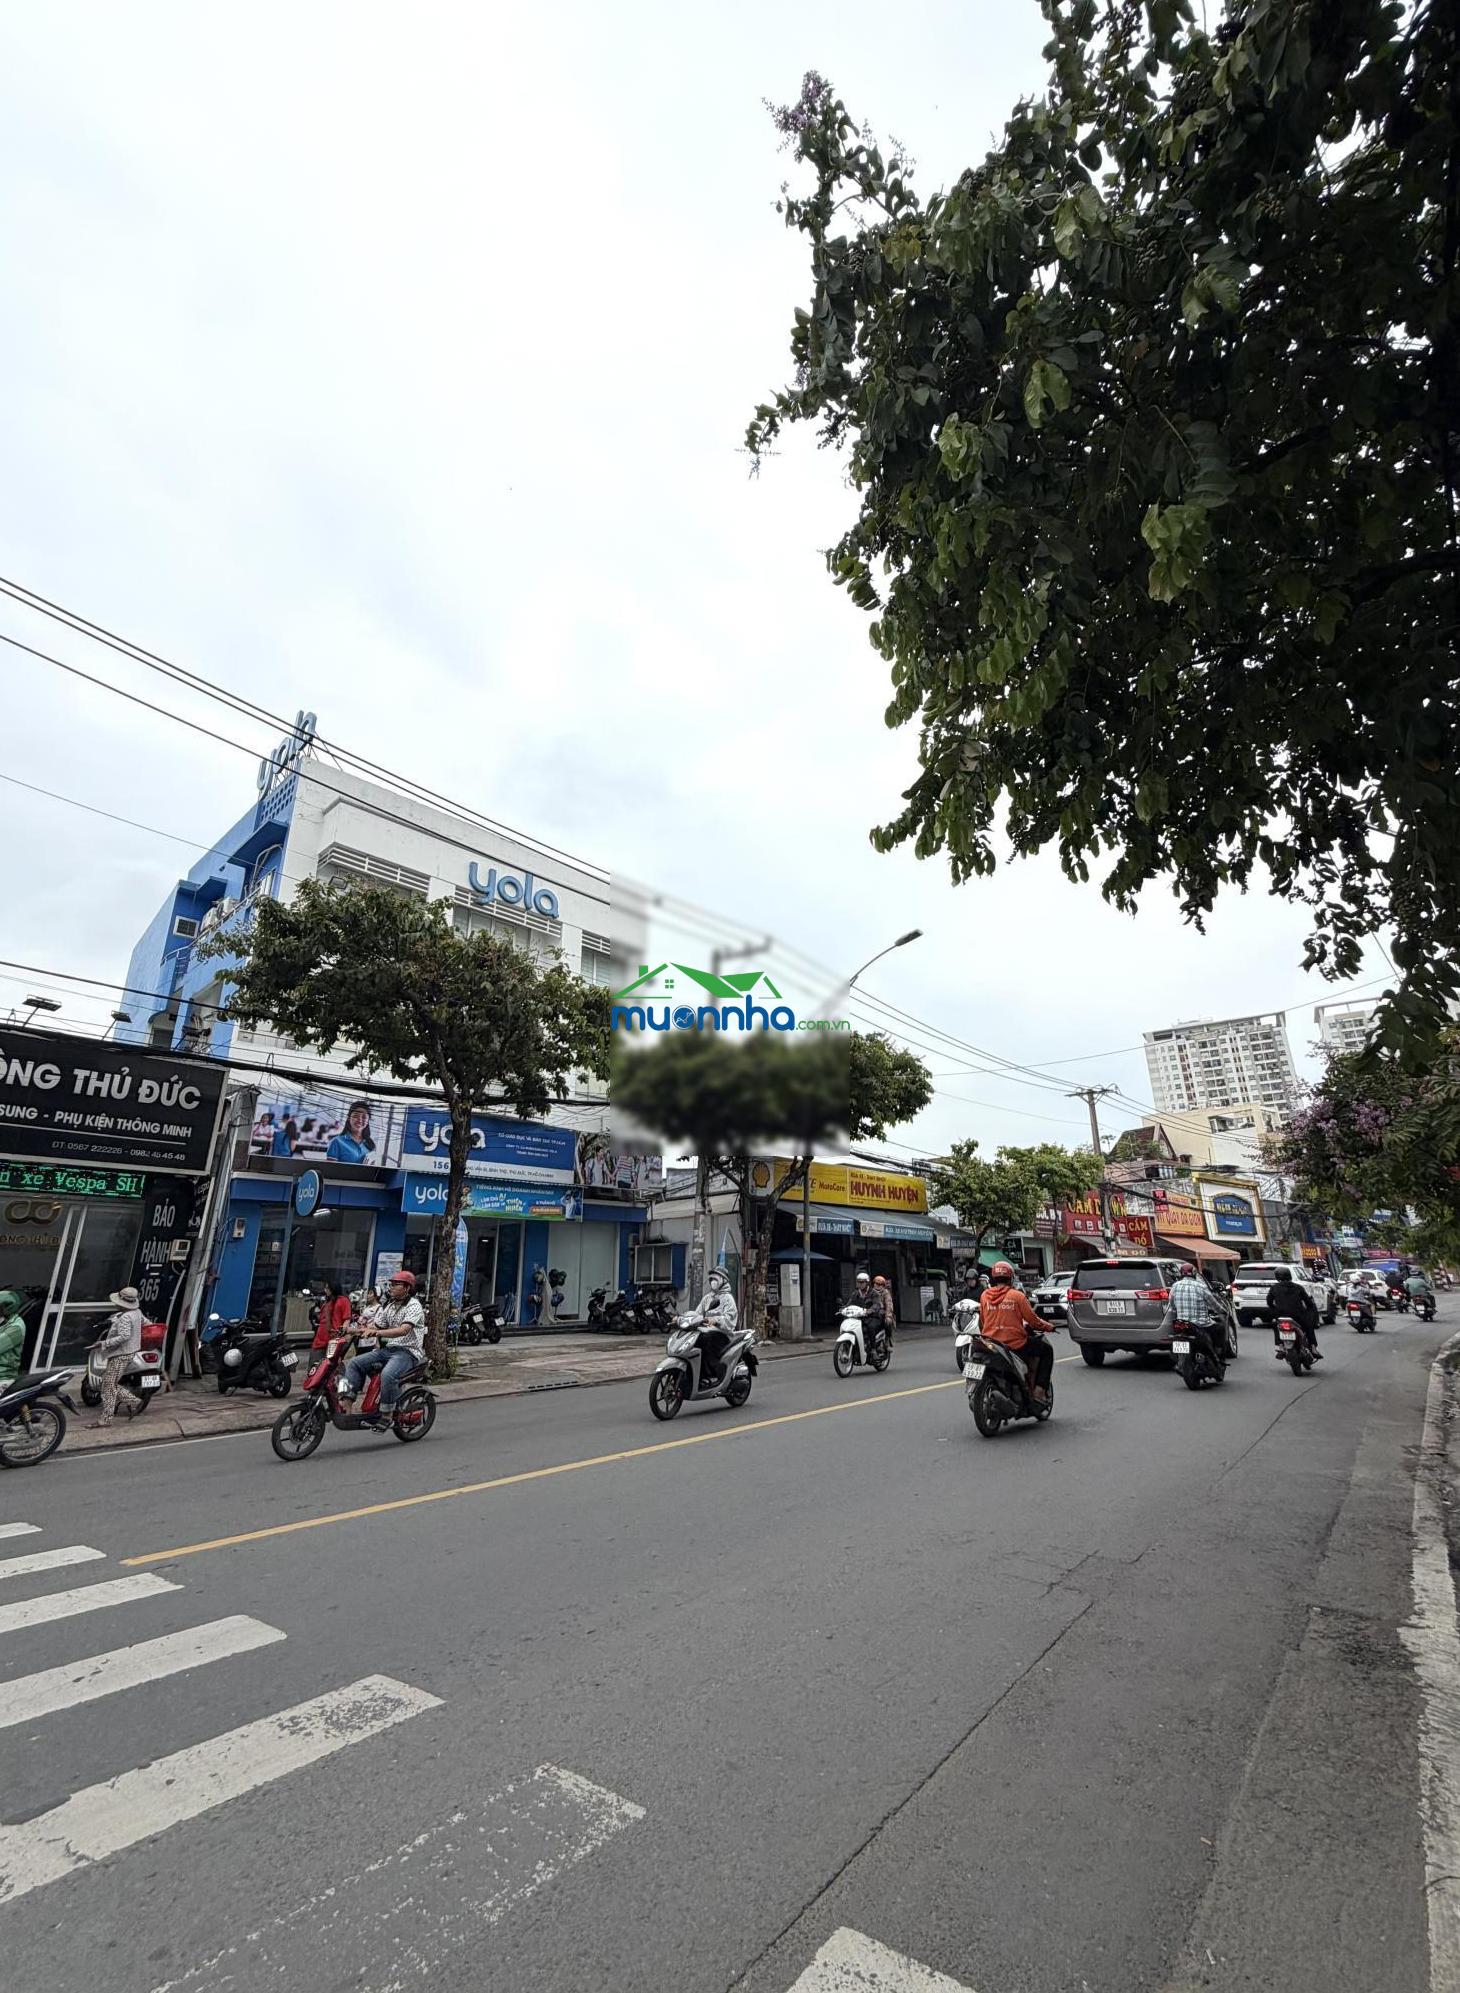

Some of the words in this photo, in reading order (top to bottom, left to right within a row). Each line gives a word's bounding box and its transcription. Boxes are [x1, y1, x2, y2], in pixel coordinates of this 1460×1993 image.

[257, 710, 318, 800] yola
[468, 861, 559, 919] yola
[73, 1066, 132, 1100] THỦ
[137, 1074, 201, 1110] ĐỨC
[54, 1110, 83, 1128] PHỤ
[84, 1113, 114, 1130] KIỆN
[117, 1117, 160, 1134] THÔNG
[162, 1123, 193, 1138] MINH
[418, 1121, 486, 1152] yoa
[20, 1172, 44, 1185] xe
[55, 1172, 107, 1191] Vespa
[116, 1177, 138, 1192] SH
[298, 1184, 315, 1201] yola
[152, 1198, 176, 1227] BẢO
[140, 1236, 171, 1264] HÀNH
[138, 1278, 160, 1301] 365
